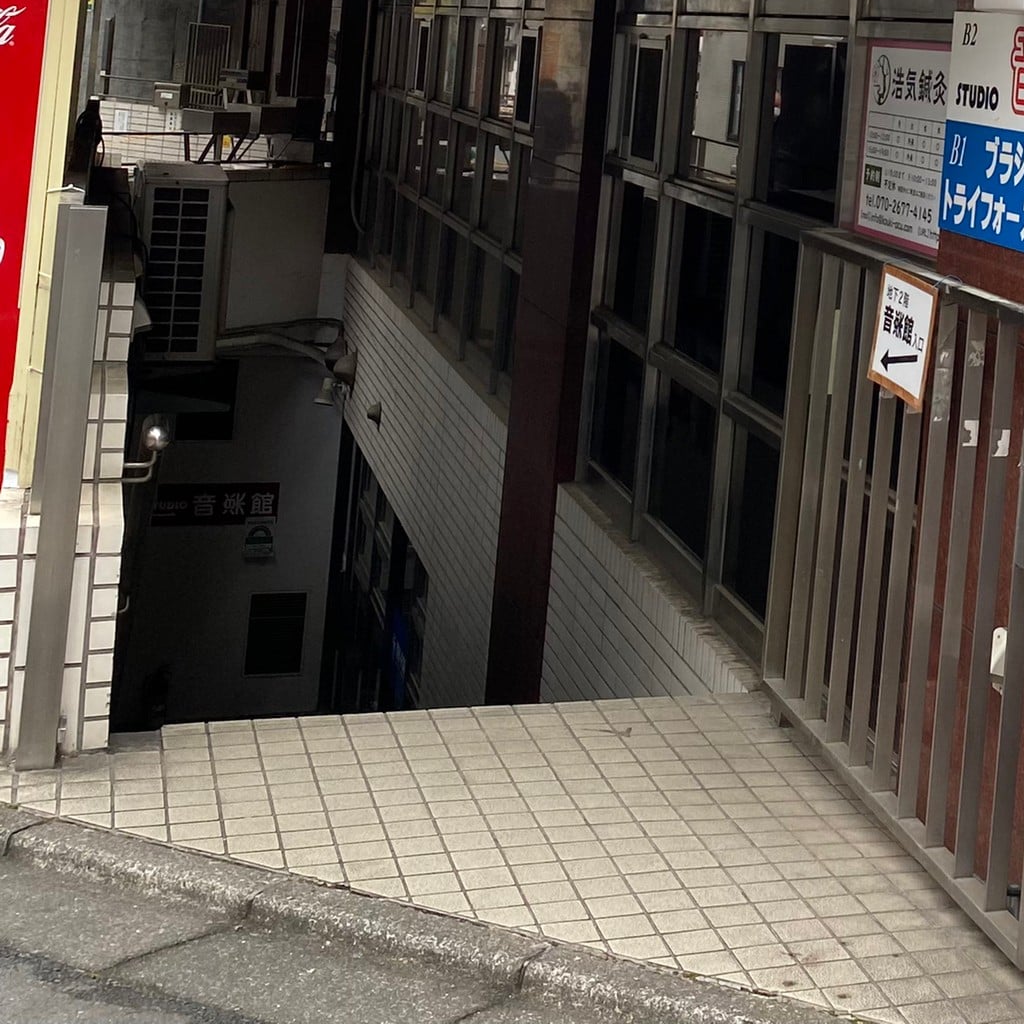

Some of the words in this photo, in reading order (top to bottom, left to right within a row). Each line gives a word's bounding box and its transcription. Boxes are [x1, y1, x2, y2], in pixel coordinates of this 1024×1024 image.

[962, 23, 978, 46] B2
[956, 83, 999, 111] STUDIO
[949, 134, 967, 167] B1
